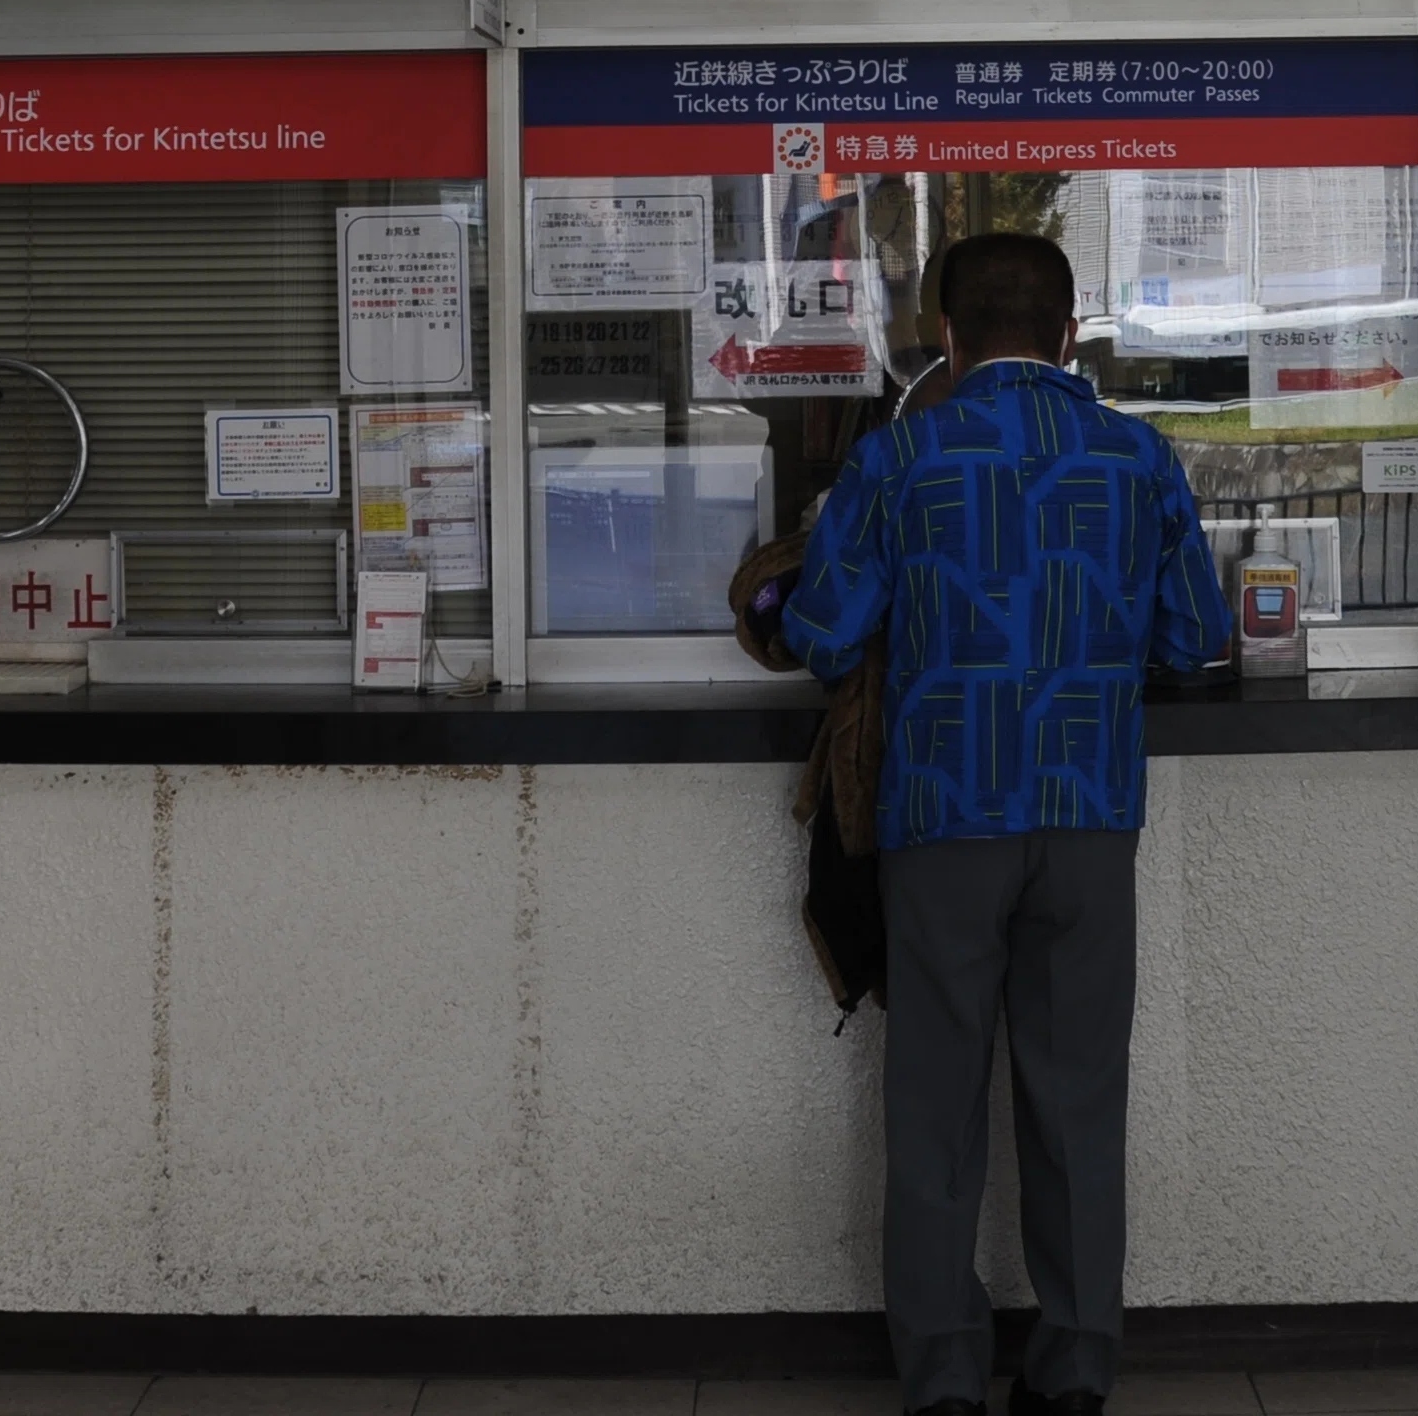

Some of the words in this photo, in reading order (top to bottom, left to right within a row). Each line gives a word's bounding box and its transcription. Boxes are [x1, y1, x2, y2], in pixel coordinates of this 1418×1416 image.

[674, 56, 909, 89] 近鉄線きっぷうりば
[955, 61, 1023, 85] 普通券
[674, 93, 751, 114] Tickets
[755, 92, 789, 114] for
[795, 92, 888, 113] Kintetsu
[893, 90, 939, 111] Line
[955, 89, 1022, 109] Regular
[1032, 88, 1092, 106] Tickets
[1103, 86, 1197, 104] Commuter
[1205, 85, 1261, 103] Passes
[1, 127, 95, 153] Tickets
[103, 126, 145, 152] for
[154, 125, 268, 152] Kintetsu
[277, 124, 326, 150] line
[835, 135, 918, 161] 特急券
[928, 138, 1009, 162] Limited
[1015, 137, 1098, 167] Express
[1104, 135, 1177, 159] Tickets
[385, 226, 421, 237] お知らせ
[586, 322, 607, 342] 20
[610, 321, 628, 341] 21
[632, 320, 651, 341] 22
[743, 374, 756, 385] JR
